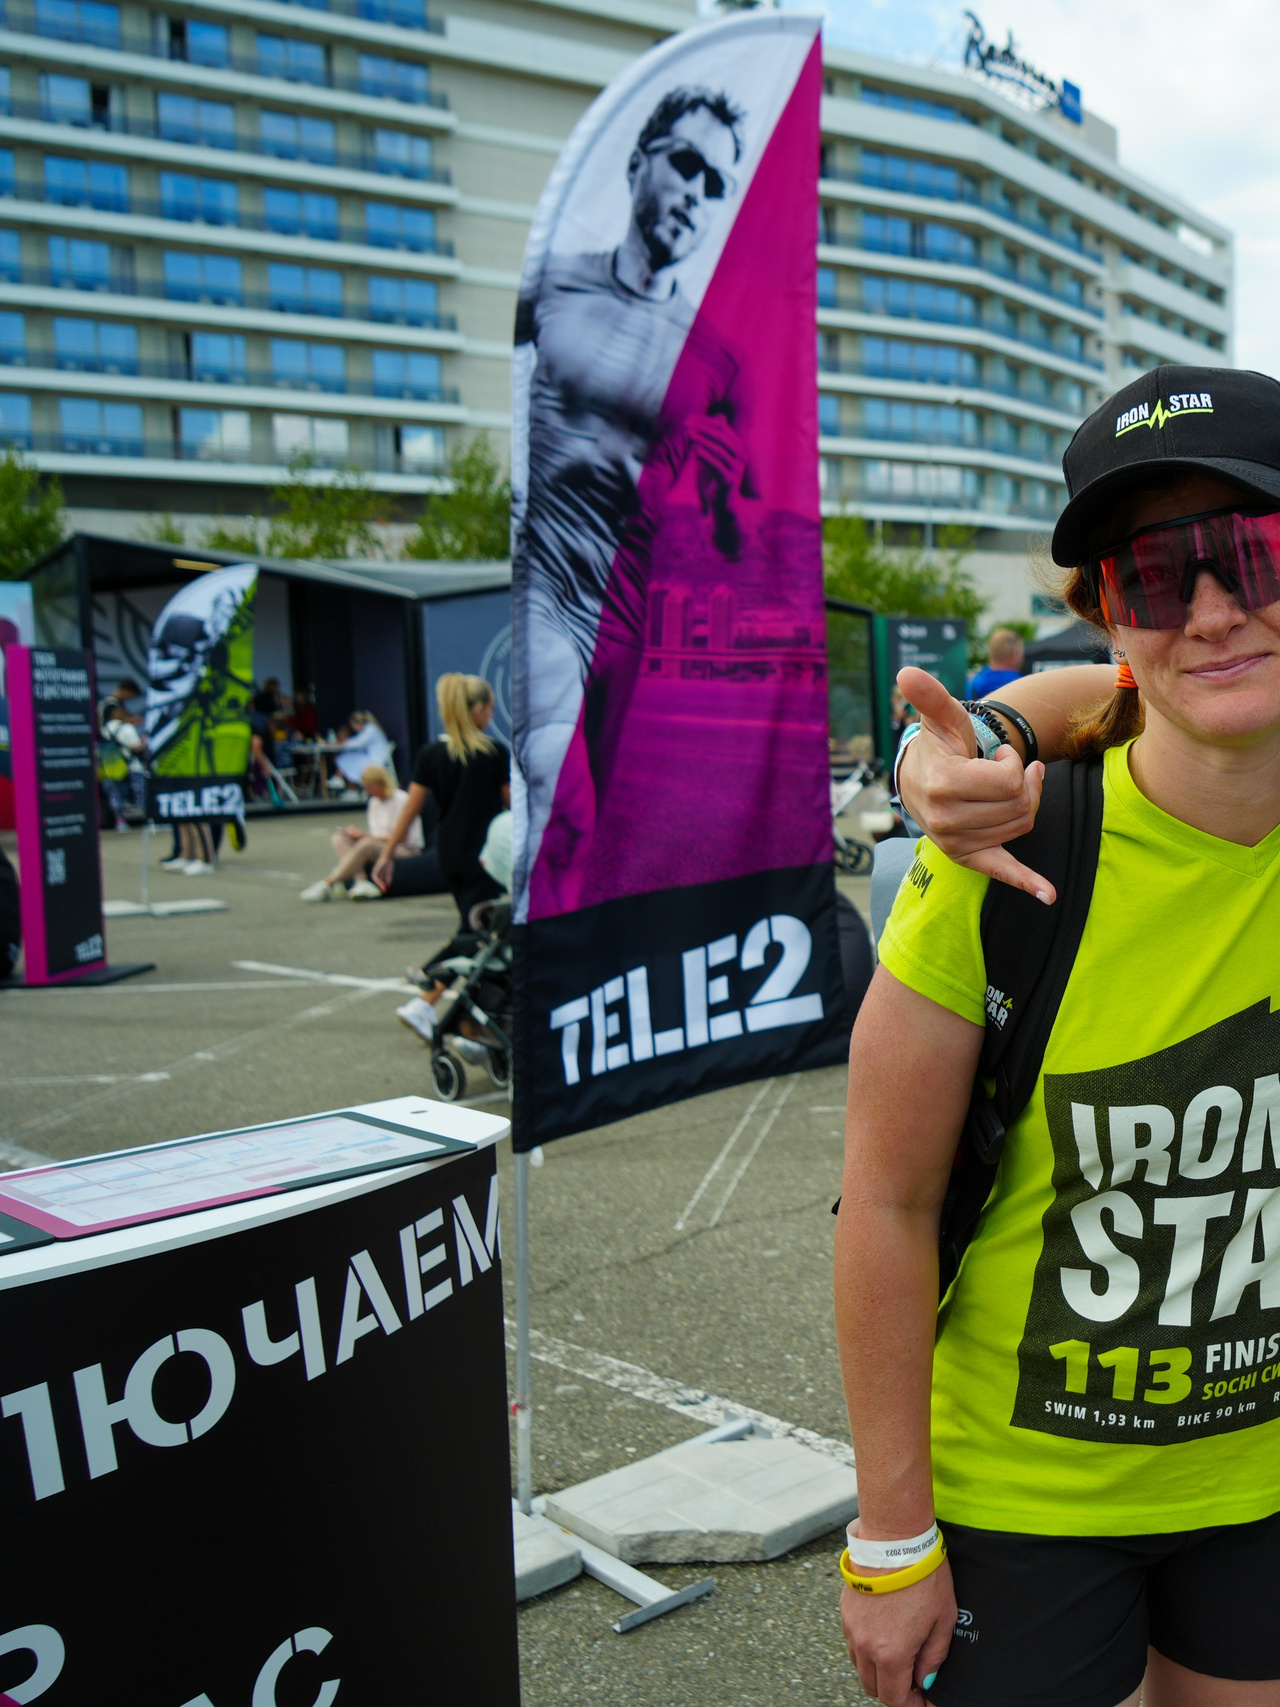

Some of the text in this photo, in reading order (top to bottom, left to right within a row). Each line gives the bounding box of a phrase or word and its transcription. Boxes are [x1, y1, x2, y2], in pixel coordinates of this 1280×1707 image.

[1116, 393, 1213, 432] IRON STAR
[155, 782, 245, 818] TELE2
[908, 857, 934, 899] MUM
[550, 914, 824, 1087] TELE2
[986, 984, 1005, 1005] ON
[986, 995, 1009, 1027] AR
[1048, 1338, 1193, 1405] 113
[1201, 1371, 1258, 1401] SOCHI
[1044, 1400, 1087, 1420] SWIM
[1093, 1410, 1127, 1427] 1,93
[1133, 1415, 1156, 1429] km
[1177, 1412, 1211, 1427] BIKE
[1216, 1406, 1233, 1419] 90
[1237, 1401, 1257, 1414] km
[885, 1549, 902, 1557] 2023
